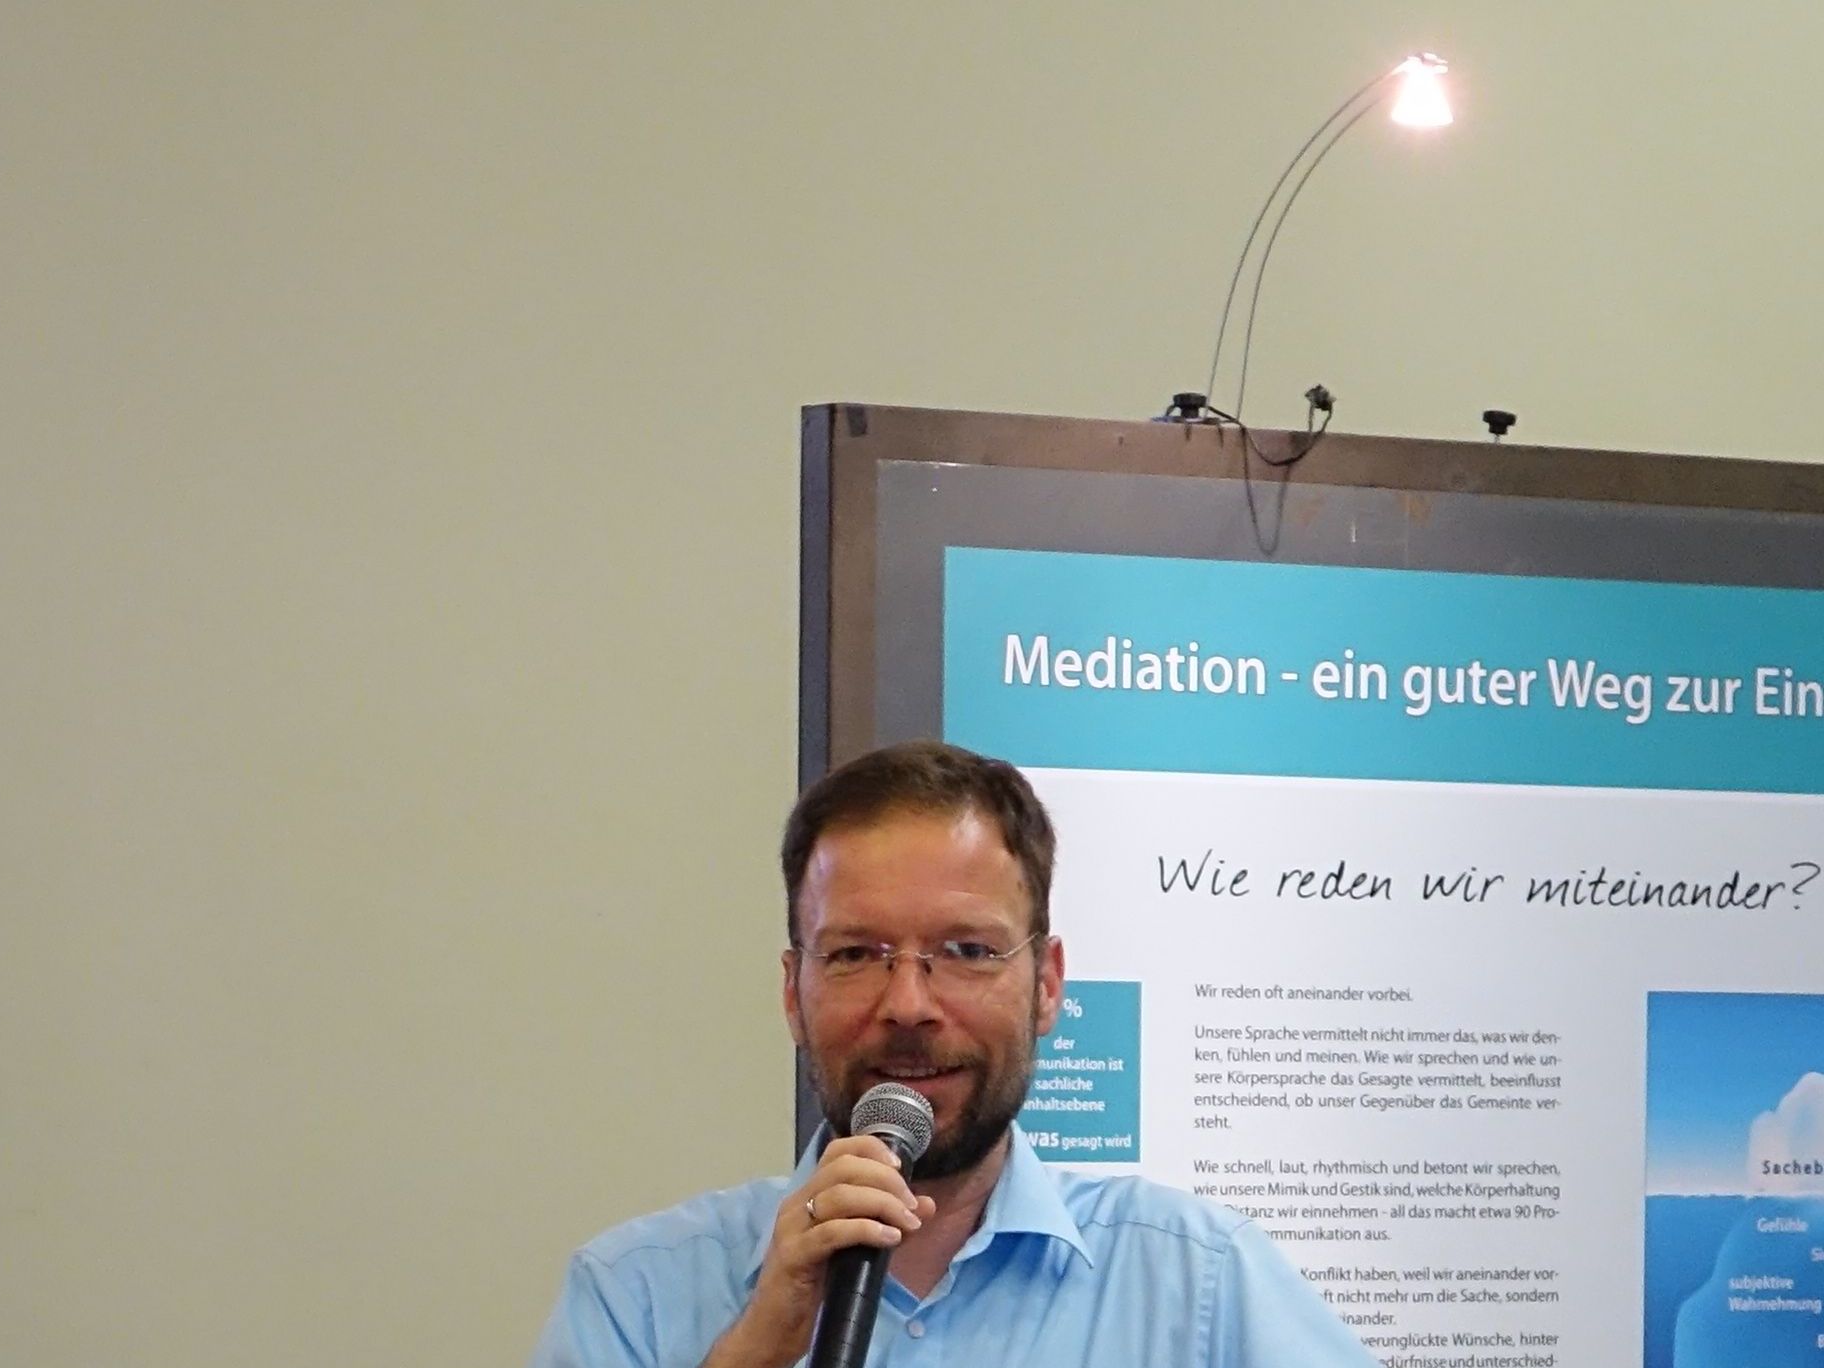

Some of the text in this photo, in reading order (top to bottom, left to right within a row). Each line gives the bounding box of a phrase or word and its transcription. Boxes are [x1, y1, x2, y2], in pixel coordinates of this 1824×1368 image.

[1004, 633, 1266, 695] Mediation
[1312, 650, 1387, 700] ein
[1404, 657, 1535, 715] guter
[1549, 659, 1653, 724] Weg
[1666, 674, 1740, 714] zur
[1158, 850, 1820, 912] Wie reden wir miteinander?
[1195, 984, 1413, 1001] Wir reden oft aneinander vorbei.
[1053, 1035, 1075, 1050] der
[1195, 1025, 1242, 1039] Unsere
[1245, 1025, 1299, 1042] Sprache
[1302, 1027, 1368, 1041] vermittelt
[1371, 1028, 1405, 1042] nicht
[1407, 1029, 1449, 1042] immer
[1482, 1032, 1506, 1043] was
[1510, 1030, 1529, 1043] wir
[1532, 1030, 1561, 1044] den-
[1036, 1057, 1124, 1071] munikation ist
[1195, 1047, 1562, 1067] ken, fühlen und meinen. Wie wir sprechen und wie un-
[1035, 1077, 1093, 1091] sachliche
[1194, 1073, 1222, 1084] sere
[1227, 1070, 1326, 1087] Körpersprache
[1330, 1071, 1354, 1085] das
[1358, 1072, 1413, 1089] Gesagte
[1490, 1073, 1561, 1088] beeinflusst
[1194, 1092, 1561, 1111] entscheidend, ob unser Gegenüber das Gemeinte ver-
[1194, 1115, 1231, 1129] steht.
[1062, 1136, 1102, 1150] gesagt
[1105, 1135, 1131, 1148] wird
[1194, 1160, 1560, 1178] Wie schnell, laut, rhythmisch und betont wir sprechen,
[1194, 1182, 1560, 1200] wie unsere Mimik und Gestik sind, welche Körperhaltung
[1278, 1204, 1297, 1218] wir
[1301, 1205, 1378, 1218] einnehmen
[1390, 1204, 1405, 1218] all
[1408, 1204, 1431, 1218] das
[1435, 1204, 1475, 1218] macht
[1479, 1206, 1511, 1218] etwa
[1514, 1205, 1530, 1218] 90
[1534, 1204, 1560, 1218] Pro-
[1265, 1226, 1392, 1240] mmunikation aus.
[1757, 1217, 1808, 1233] Gefühle
[1354, 1267, 1400, 1282] haben,
[1403, 1267, 1430, 1280] weil
[1433, 1268, 1452, 1281] wir
[1456, 1268, 1531, 1281] aneinander
[1534, 1270, 1558, 1281] vor-
[1729, 1276, 1794, 1292] subjektive
[1337, 1289, 1370, 1303] nicht
[1375, 1289, 1409, 1303] mehr
[1413, 1292, 1434, 1303] um
[1437, 1289, 1457, 1303] die
[1460, 1289, 1502, 1304] Sache,
[1506, 1289, 1559, 1303] sondern
[1728, 1296, 1823, 1314] Wahrnehmung
[1361, 1333, 1558, 1349] verunglückte Wünsche, hinter
[1449, 1355, 1475, 1368] und
[1476, 1355, 1557, 1368] unterschied-
